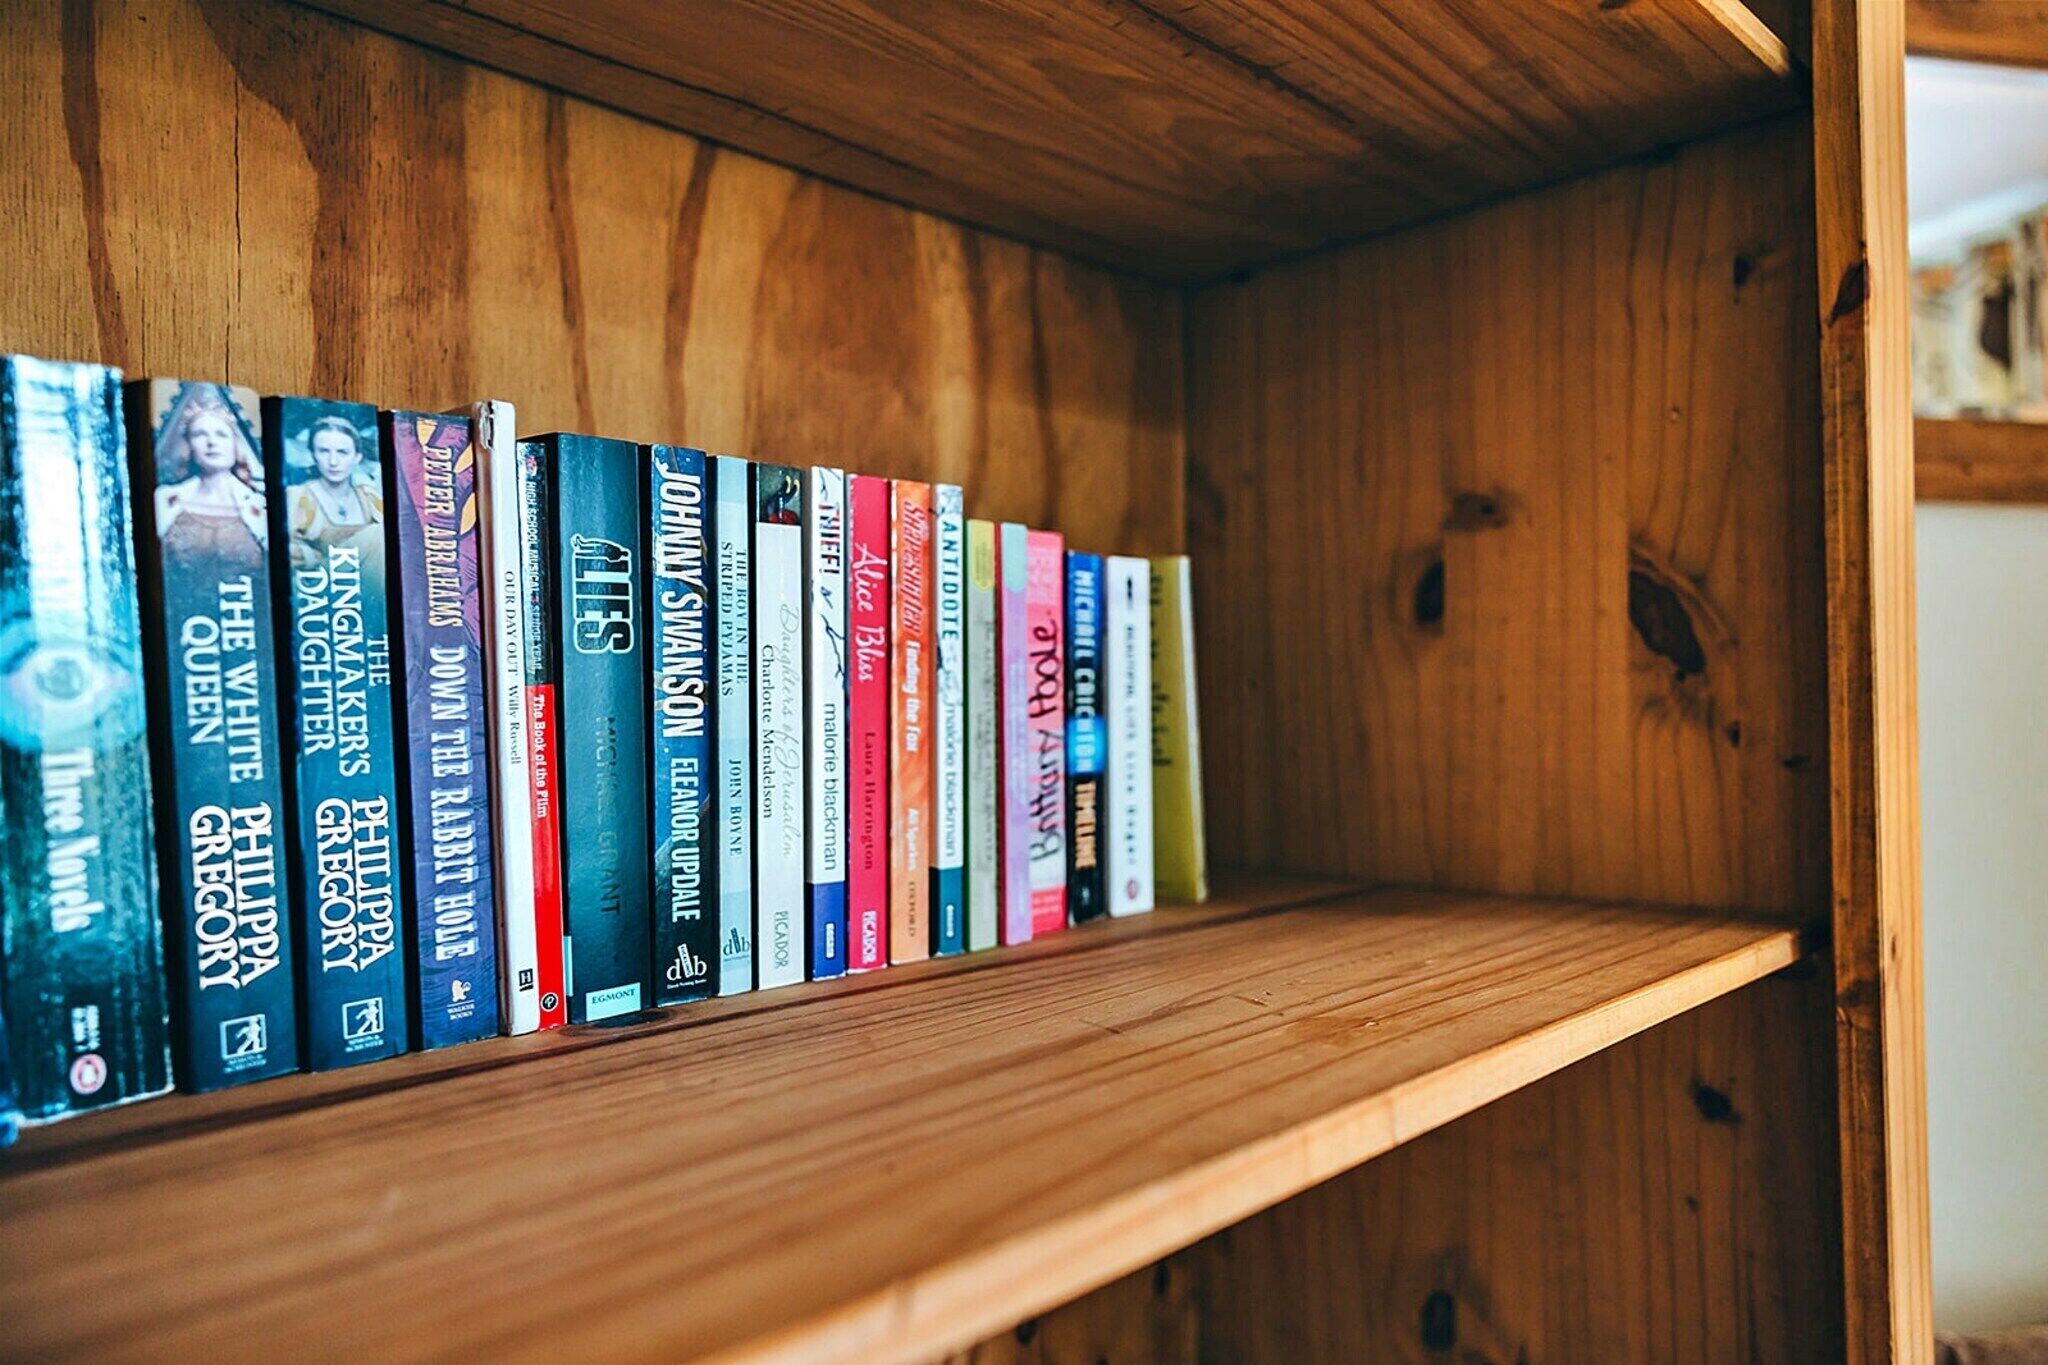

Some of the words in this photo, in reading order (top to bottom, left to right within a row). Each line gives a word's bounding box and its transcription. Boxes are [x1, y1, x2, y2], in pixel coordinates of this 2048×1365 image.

[422, 445, 457, 516] PETER
[525, 480, 538, 506] HIGH
[527, 507, 539, 547] SCHOOL
[655, 457, 705, 588] JOHNNY
[818, 502, 841, 575] THIEF!
[424, 524, 465, 628] ABRAHAMS
[504, 571, 516, 604] OUR
[528, 549, 540, 594] MUSICAL
[572, 548, 635, 654] LIES
[721, 541, 734, 615] STRIPED
[735, 549, 748, 582] THE
[852, 542, 888, 613] Alice
[942, 521, 959, 640] ANTIDOTE
[217, 576, 257, 652] THE
[505, 609, 518, 642] DAY
[736, 587, 748, 622] BOY
[736, 626, 748, 644] IN
[1073, 569, 1097, 660] MICHAEL
[181, 615, 226, 746] QUEEN
[294, 569, 336, 757] DAUGHTER
[328, 545, 371, 778] KINGMAKER'S
[367, 633, 391, 688] THE
[429, 646, 469, 721] DOWN
[506, 642, 519, 676] OUT
[660, 590, 705, 737] SWANSON
[721, 620, 734, 696] PYJAMAS
[736, 654, 748, 684] THE
[761, 644, 776, 723] Charlotte
[855, 625, 887, 684] Bliss
[220, 659, 264, 784] WHITE
[506, 685, 519, 717] Willy
[533, 694, 546, 719] The
[534, 721, 547, 754] Book
[1074, 667, 1097, 774] CRICHTON
[430, 728, 474, 779] THE
[510, 721, 522, 765] Russell
[535, 755, 547, 768] of
[595, 715, 619, 826] MICHA
[762, 729, 777, 819] Mendelson
[823, 703, 839, 773] malorie
[864, 732, 877, 775] Laura
[41, 749, 96, 834] Three
[535, 768, 548, 788] the
[536, 790, 549, 818] Film
[669, 756, 701, 843] ELEANOR
[728, 759, 742, 798] JOHN
[430, 786, 477, 886] RABBIT
[730, 806, 743, 857] BOYNE
[823, 778, 839, 871] blackman
[861, 781, 876, 870] Harrington
[46, 835, 106, 933] Novels
[189, 804, 241, 992] GREGORY
[229, 801, 281, 987] PHILIPPA
[314, 797, 359, 973] GREGORY
[351, 795, 395, 972] PHILIPPA
[671, 846, 701, 923] UPDALE
[434, 897, 480, 962] HOLE
[773, 910, 789, 969] PICADOR
[592, 988, 636, 1005] EGMONT
